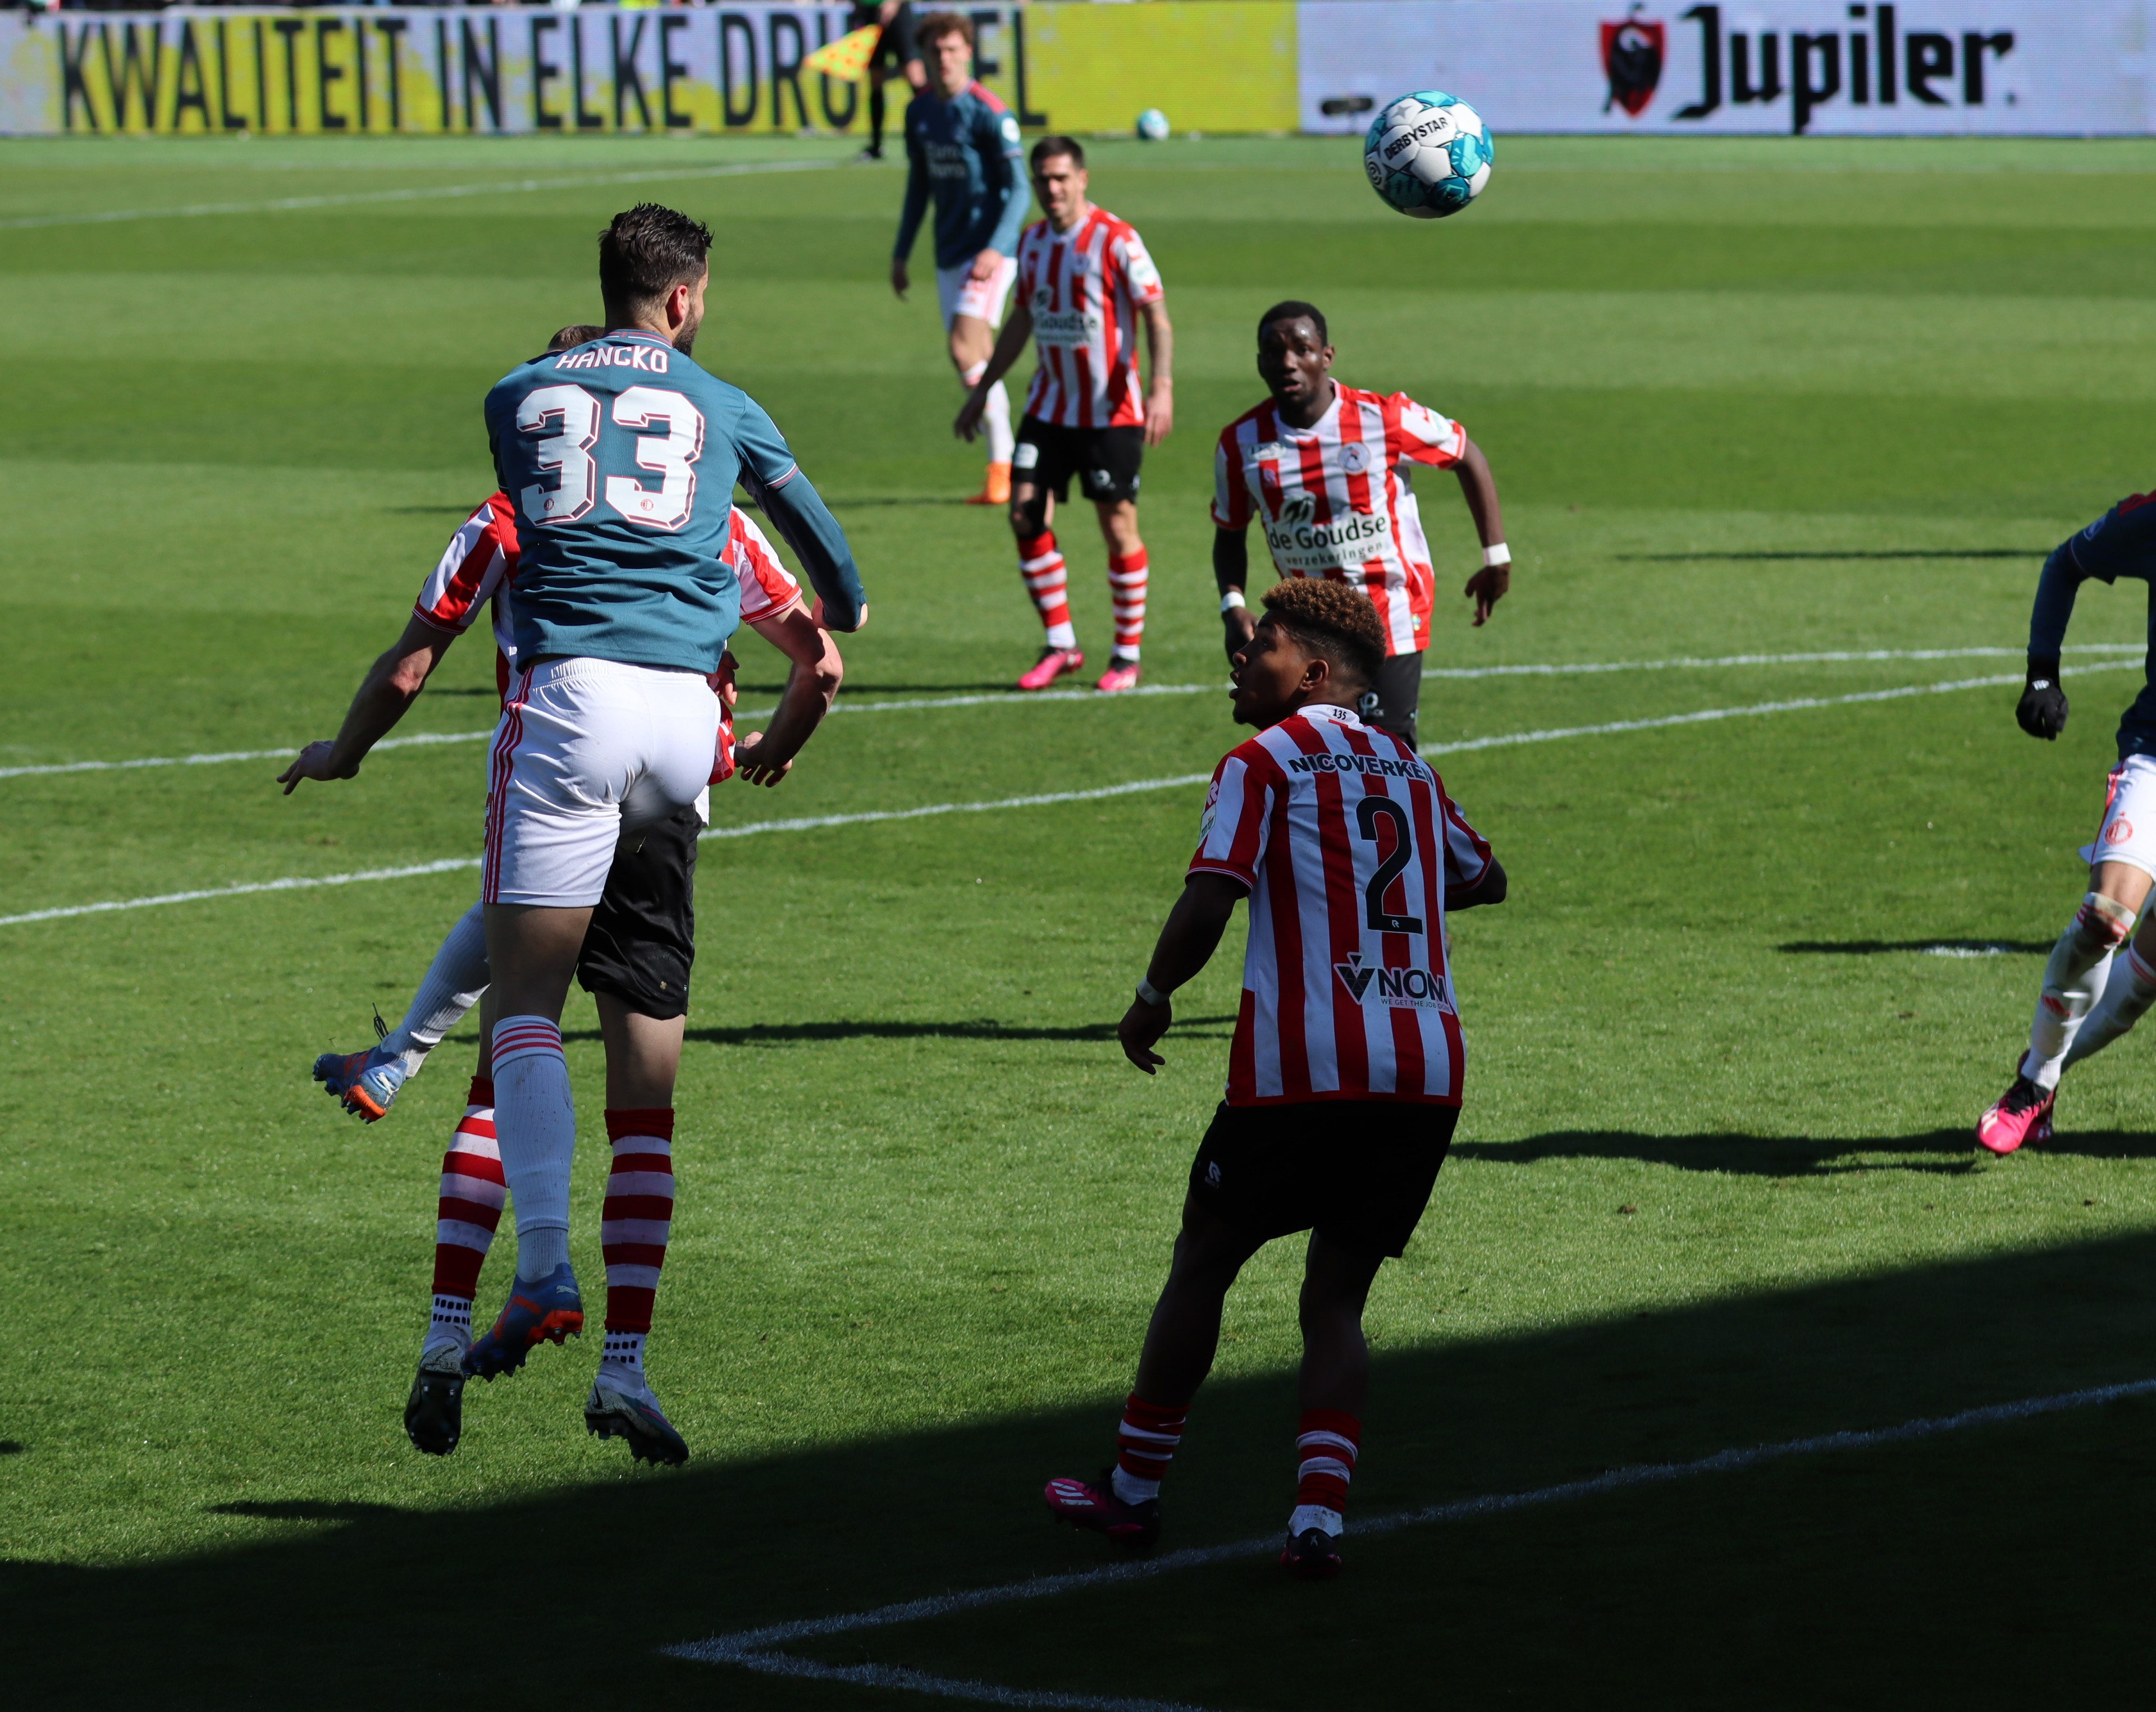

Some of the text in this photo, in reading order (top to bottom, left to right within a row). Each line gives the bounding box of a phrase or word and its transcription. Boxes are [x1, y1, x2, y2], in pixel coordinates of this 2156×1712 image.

[58, 9, 1047, 129] KWALITEIT IN ELKE DRUEL
[1383, 117, 1449, 161] DERBYSTAR
[555, 344, 668, 374] HANCKO
[515, 383, 705, 531] 33
[1269, 515, 1386, 550] de Goudse
[1332, 708, 1347, 720] 135
[1355, 795, 1423, 935] 2
